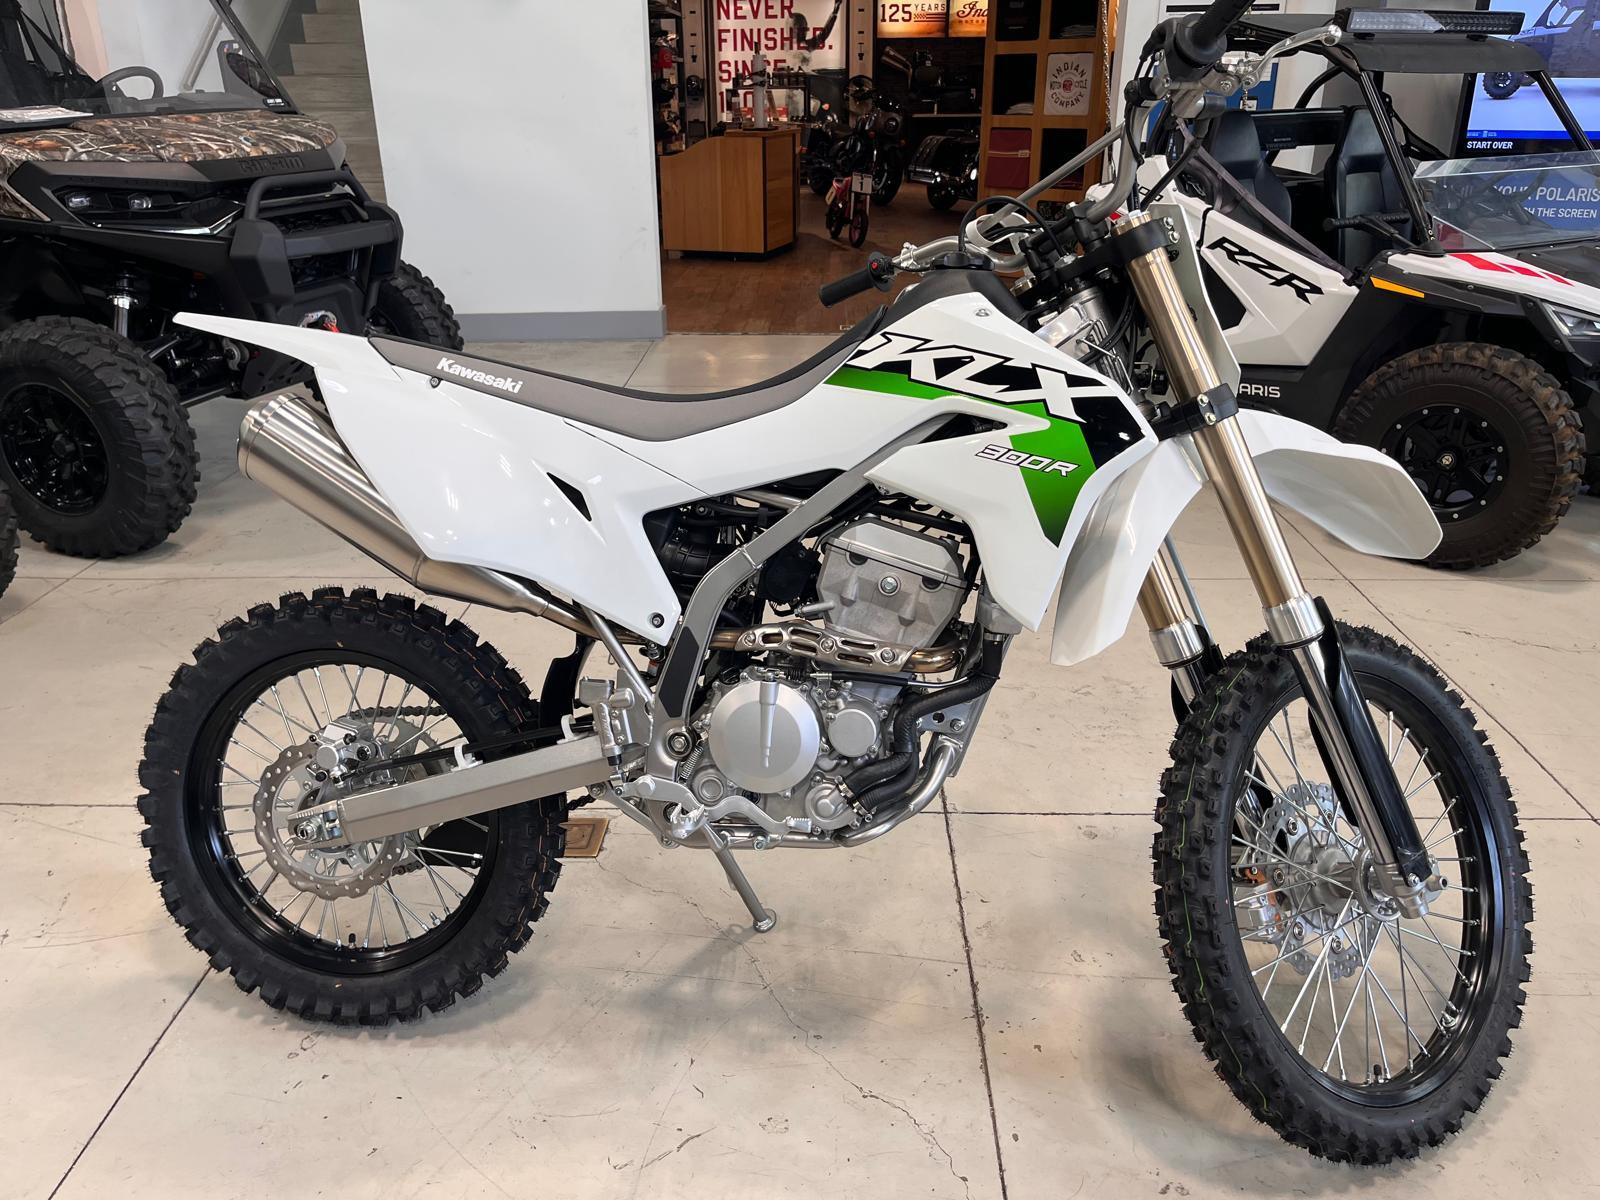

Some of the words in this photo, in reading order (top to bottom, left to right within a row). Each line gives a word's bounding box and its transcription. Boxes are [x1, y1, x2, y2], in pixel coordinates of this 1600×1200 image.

[716, 0, 794, 20] NEVER
[880, 3, 912, 23] 125
[914, 3, 946, 12] YEARS
[1052, 61, 1087, 79] INDIAN
[1051, 91, 1084, 108] COMPANY
[1466, 141, 1492, 149] START
[1493, 141, 1513, 150] OVER
[1535, 187, 1600, 202] POLARIS
[1537, 207, 1556, 217] THE
[1557, 207, 1597, 218] SCREEN
[1206, 236, 1325, 304] RZR
[436, 357, 524, 394] Kawasaki
[845, 331, 1118, 424] KLX
[974, 444, 1079, 477] 300R
